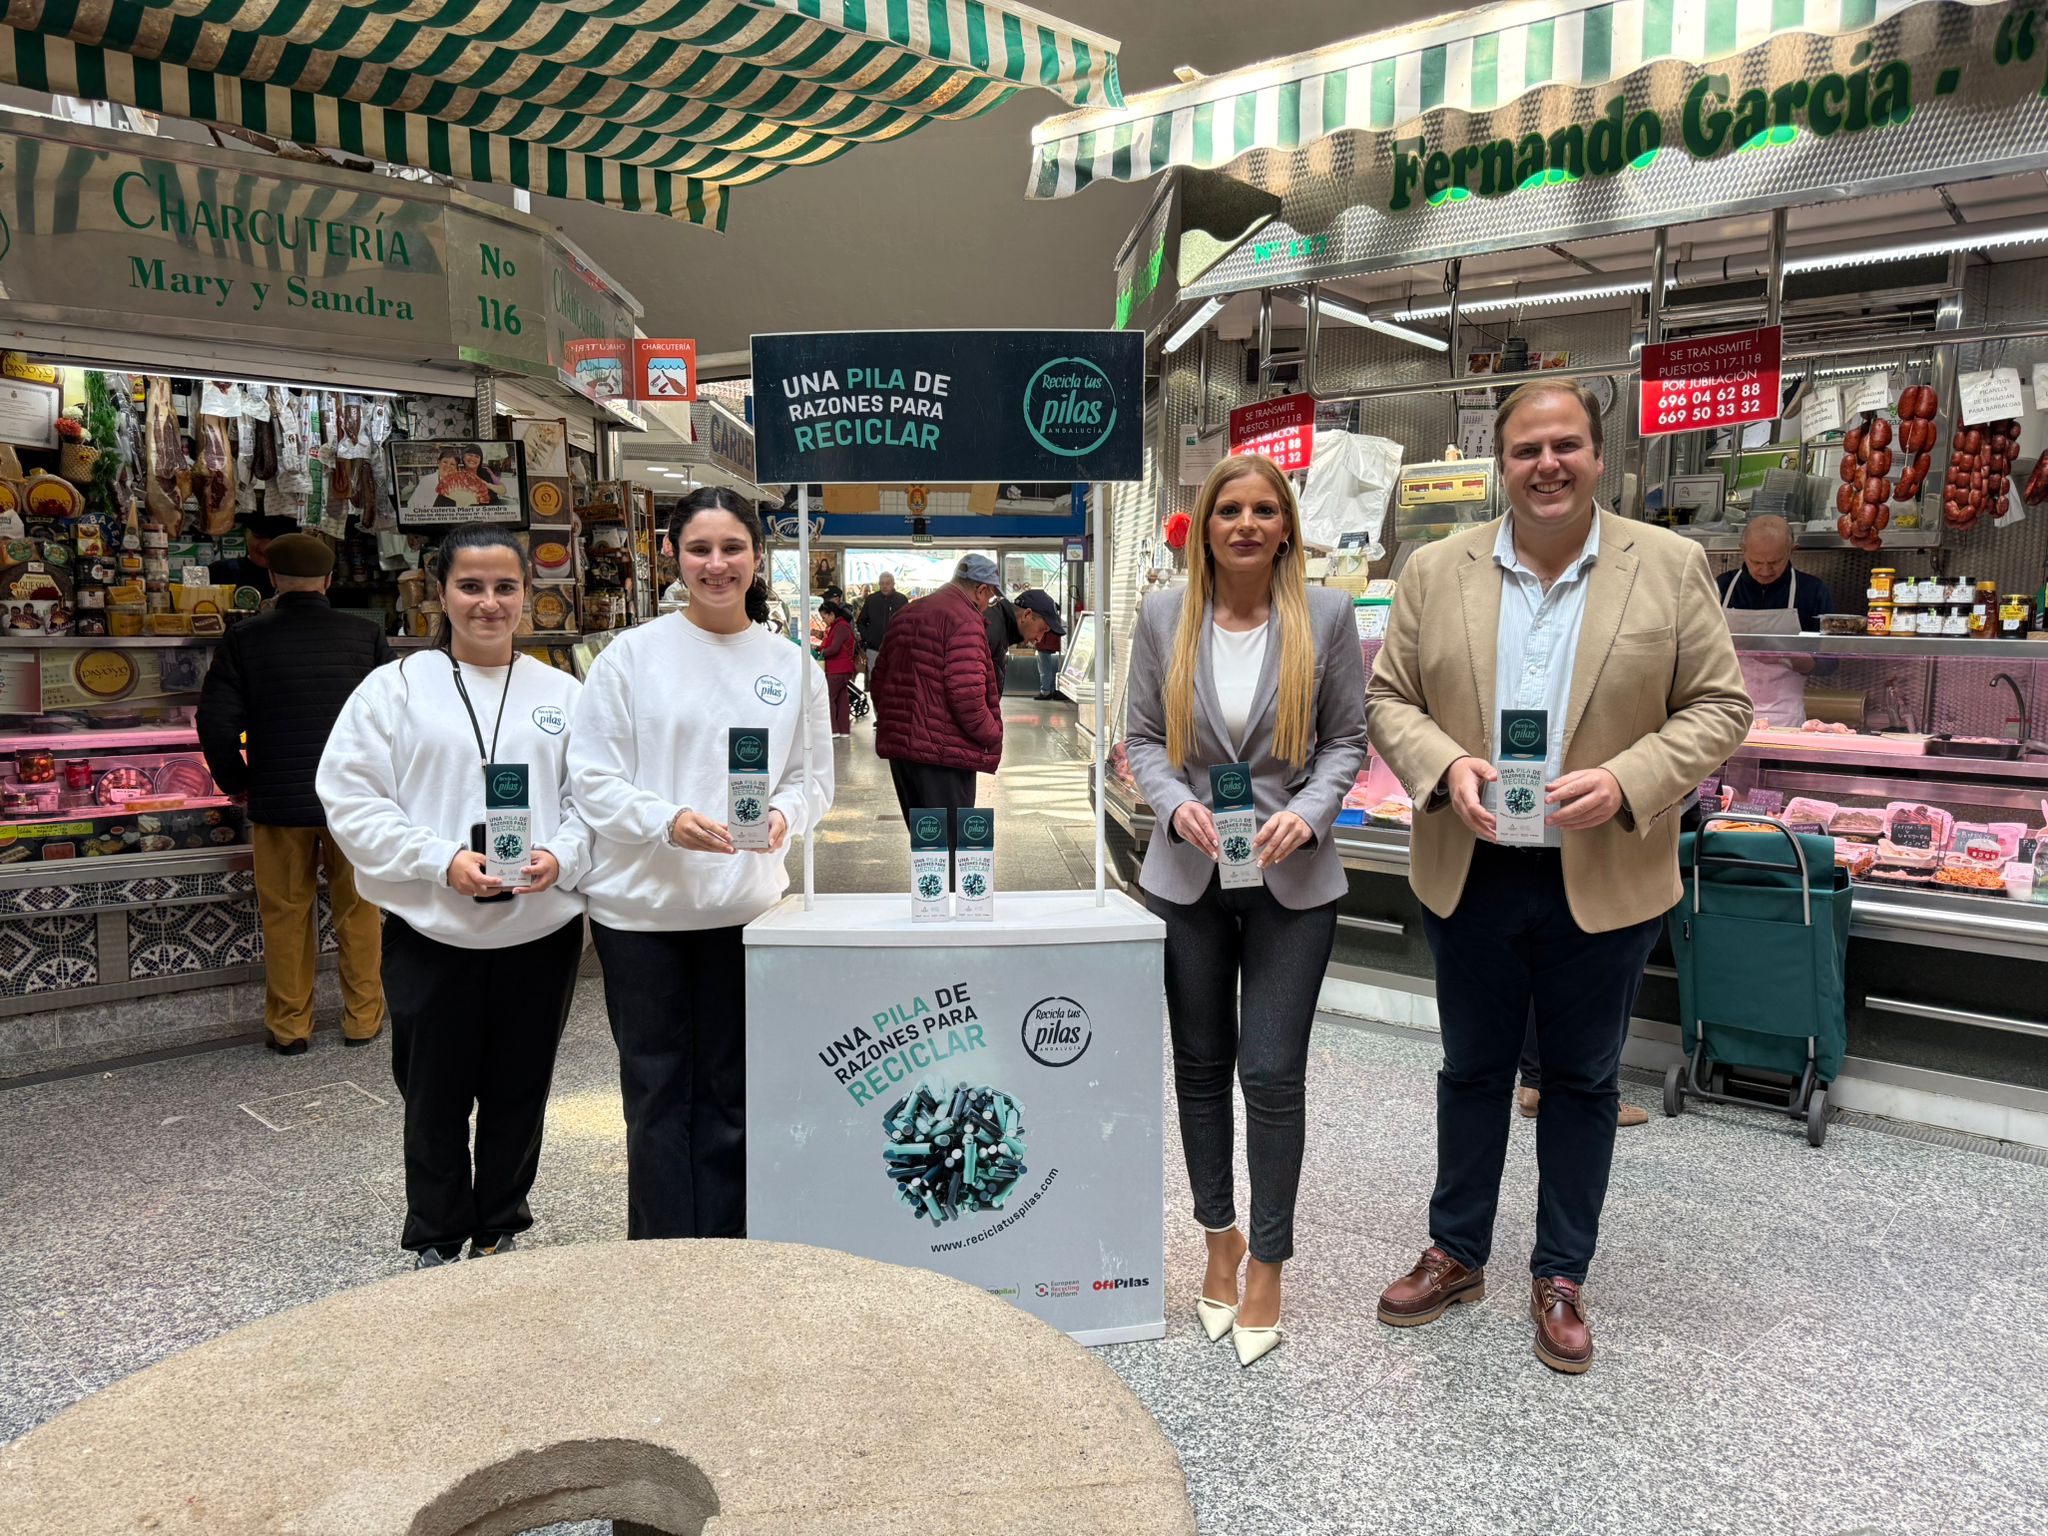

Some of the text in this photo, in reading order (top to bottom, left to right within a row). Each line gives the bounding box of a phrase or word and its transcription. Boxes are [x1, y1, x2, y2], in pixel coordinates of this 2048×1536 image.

[1389, 96, 1661, 211] Fernando
[1682, 41, 1913, 158] García
[112, 171, 411, 266] CHARCUTERÍA
[1289, 234, 1328, 257] 117
[128, 255, 415, 321] Mary y Sandra
[477, 295, 522, 335] 116
[641, 342, 691, 351] CHARCUTERÍA
[1669, 339, 1752, 361] SE TRANSMITE
[1659, 353, 1762, 377] PUESTOS 117-118
[782, 367, 952, 399] UNA PILA DE
[1042, 372, 1103, 389] Recicla tus
[1662, 368, 1758, 392] POR JUBILACIÓN
[788, 395, 944, 422] RAZONES PARA
[1658, 383, 1760, 409] 696 04 62 88
[1040, 389, 1103, 434] pilas
[1239, 413, 1302, 435] PUESTOS 117-118
[1245, 402, 1296, 421] SE TRANSMITE
[1658, 399, 1760, 425] 669 50 33 32
[793, 418, 940, 453] RECICLAR
[1273, 440, 1286, 453] 62
[1288, 437, 1302, 450] 88
[1288, 451, 1302, 464] 32
[540, 714, 562, 726] pilas
[818, 981, 971, 1068] UNA PILA DE
[1035, 1007, 1081, 1021] Recicla tus
[834, 1005, 978, 1085] RAZONES PARA
[1033, 1019, 1081, 1052] pilas
[846, 1023, 987, 1108] RECICLAR
[930, 1167, 1059, 1253] www.reciclatuspilas.com
[1050, 1279, 1080, 1287] European
[1050, 1285, 1080, 1293] Recycling
[1050, 1290, 1078, 1298] Platform
